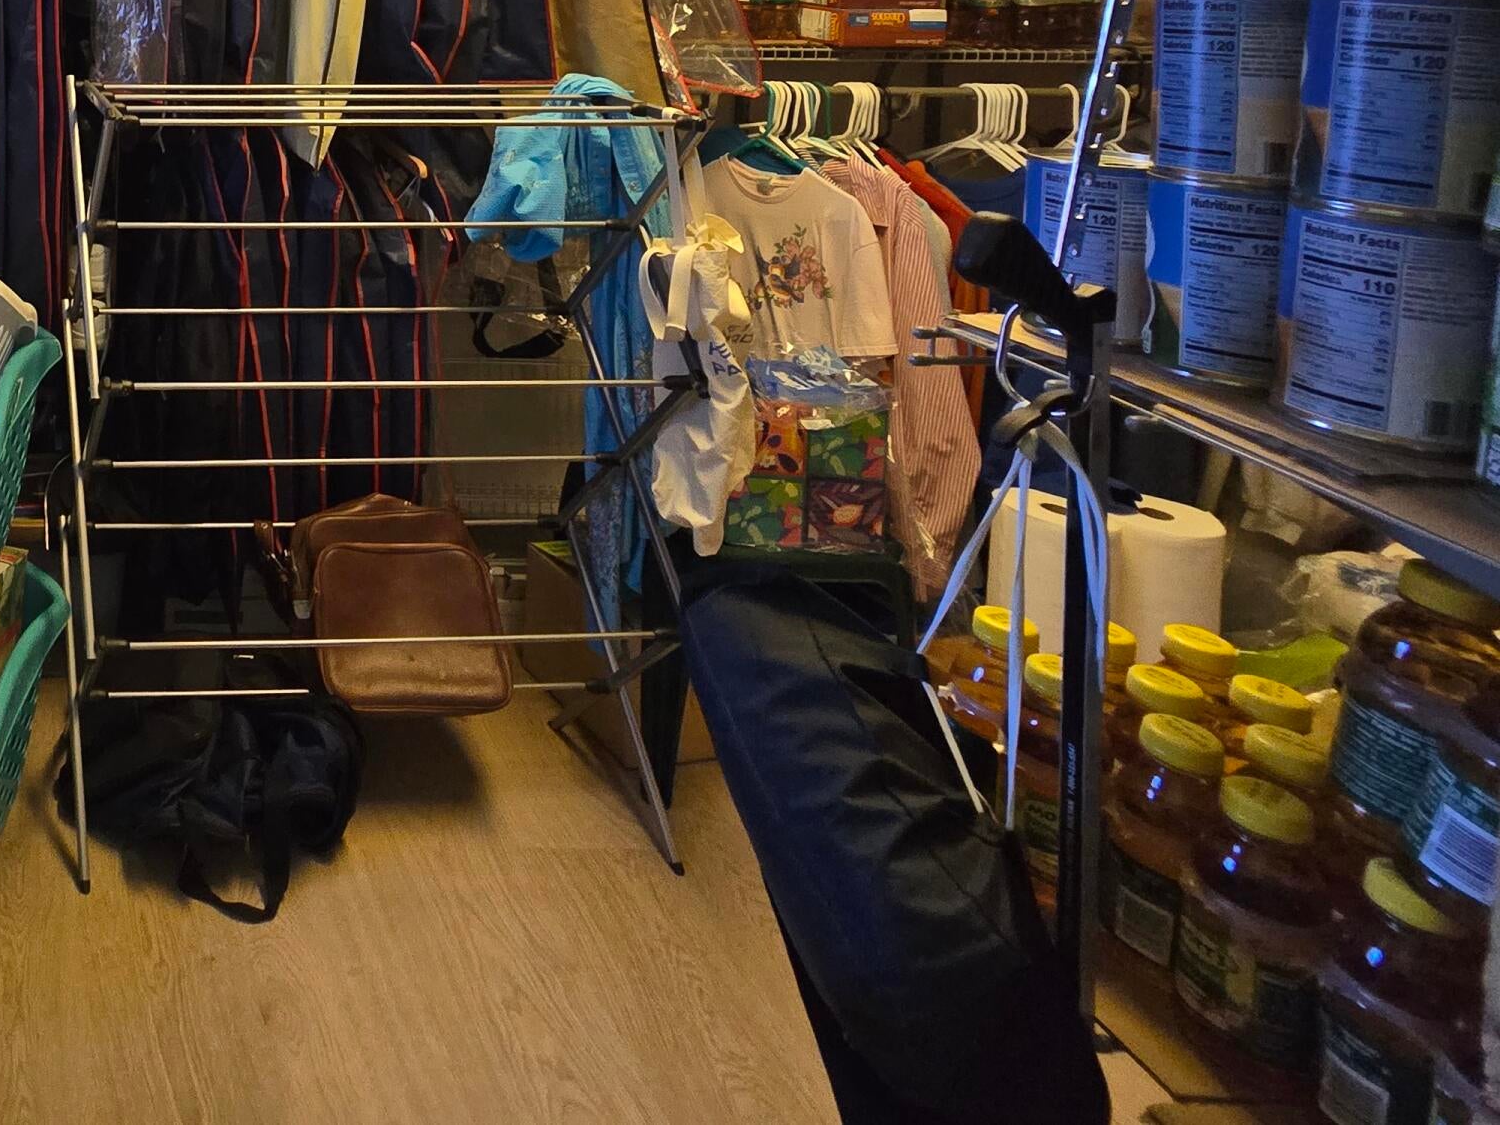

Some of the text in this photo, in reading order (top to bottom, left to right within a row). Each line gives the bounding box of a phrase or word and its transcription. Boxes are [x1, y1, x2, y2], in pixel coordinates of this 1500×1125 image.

[1204, 1, 1236, 12] Facts
[1409, 9, 1452, 24] Facts
[1208, 40, 1235, 52] 120
[1412, 56, 1446, 70] 120
[1190, 197, 1243, 213] Nutrition
[1092, 215, 1117, 227] 120
[1304, 223, 1401, 251] Nutrition Facts
[1189, 237, 1280, 256] Calories 120
[1363, 279, 1396, 295] 110
